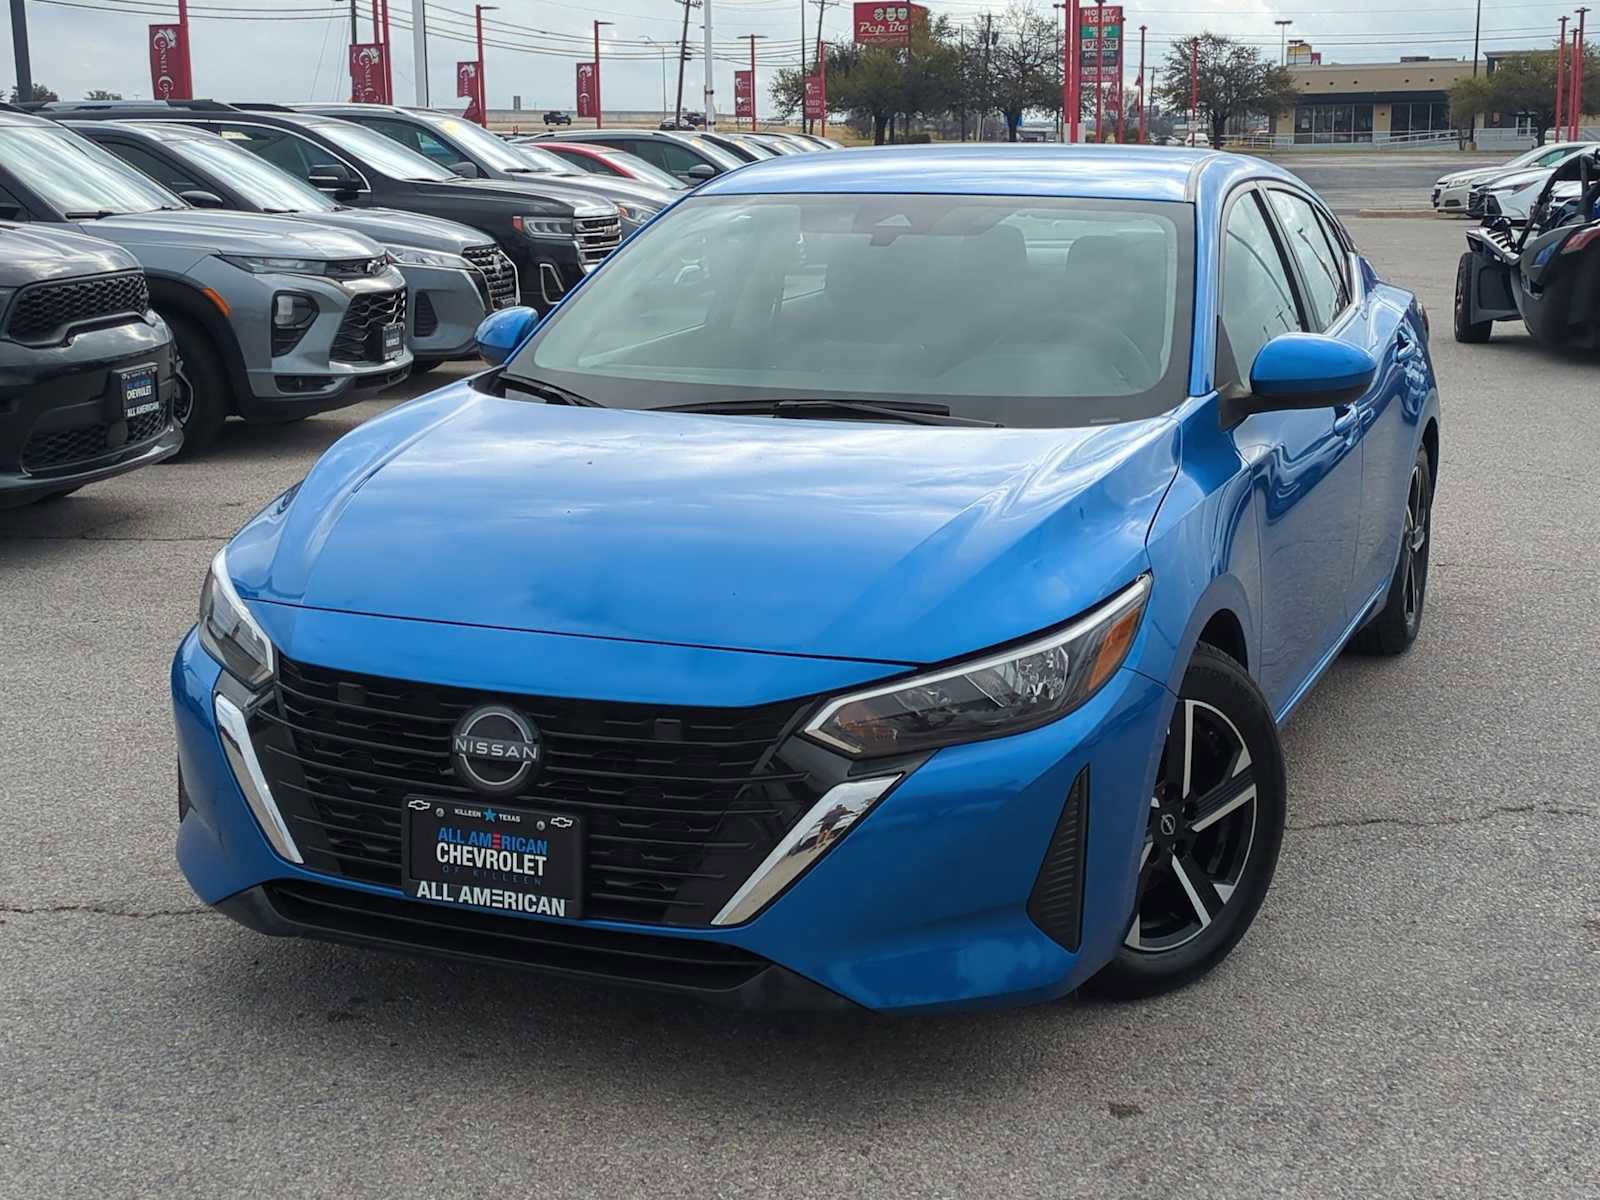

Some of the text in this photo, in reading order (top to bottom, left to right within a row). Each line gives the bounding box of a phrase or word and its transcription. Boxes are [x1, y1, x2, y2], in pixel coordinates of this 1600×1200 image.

[1084, 8, 1114, 16] HOBY
[1088, 15, 1117, 23] LOBY
[888, 21, 908, 32] Bo
[455, 738, 537, 759] NISSAN
[454, 808, 521, 823] KILLEEN TEXAS
[438, 827, 548, 855] ALL AMERICAN
[436, 842, 547, 876] CHEVROLET
[416, 880, 566, 917] ALL AMERICAN
